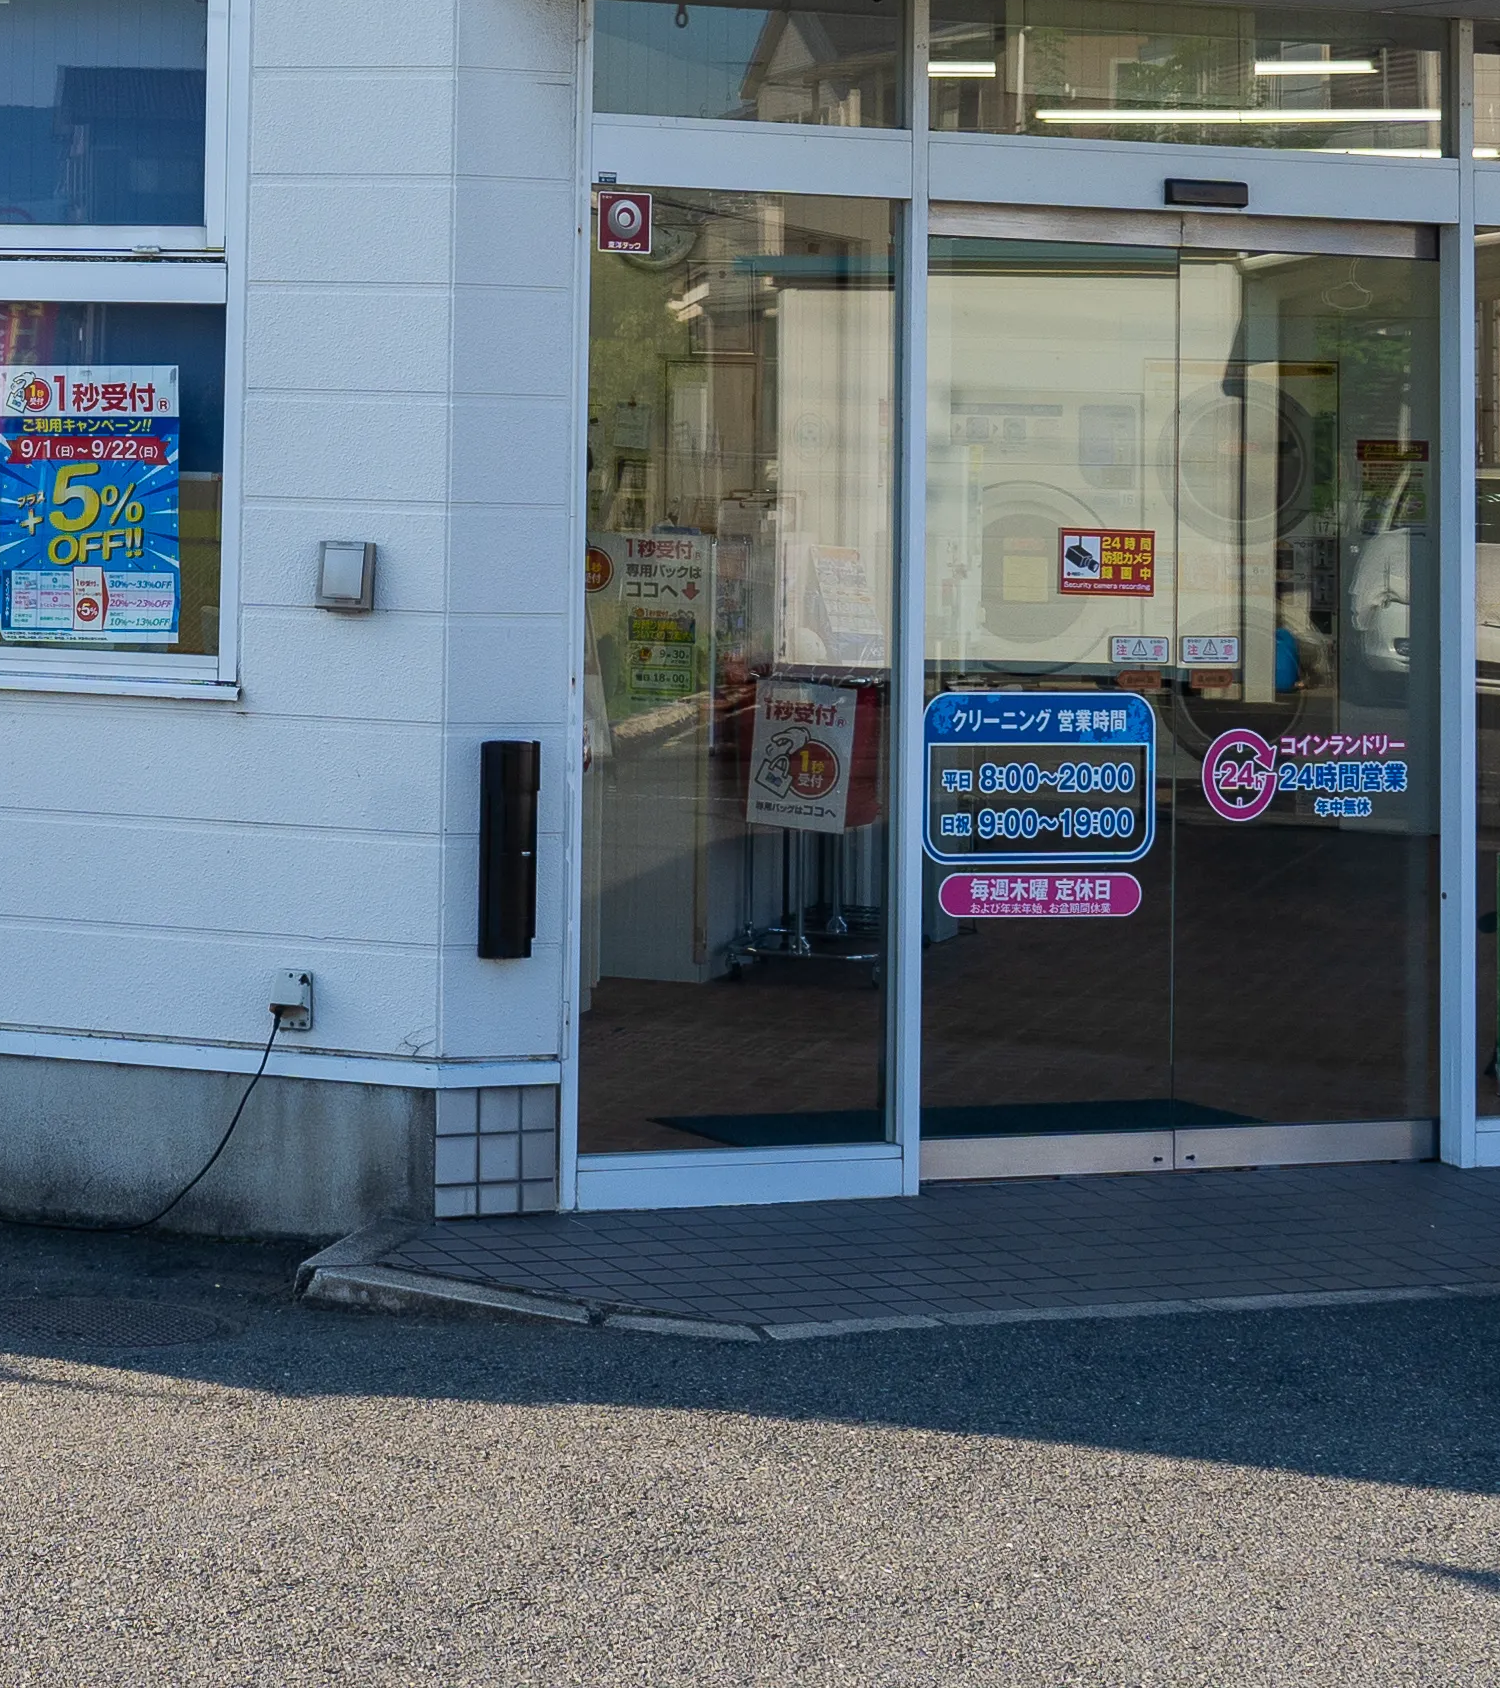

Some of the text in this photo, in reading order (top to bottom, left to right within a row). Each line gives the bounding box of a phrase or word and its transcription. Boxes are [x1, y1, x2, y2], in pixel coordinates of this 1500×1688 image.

[48, 527, 144, 564] OFF!!
[1102, 551, 1151, 564] 防犯カメラ
[1064, 581, 1091, 589] Security
[1119, 583, 1150, 591] recording
[952, 708, 1127, 733] クリーニング 営業時間
[1281, 735, 1405, 756] コインランドリー
[941, 770, 972, 792] 平日
[1278, 761, 1407, 792] 24時間営業
[1314, 796, 1372, 817] 年中無休
[941, 815, 971, 835] 日祝
[970, 879, 1110, 901] 毎週木曜 定休日
